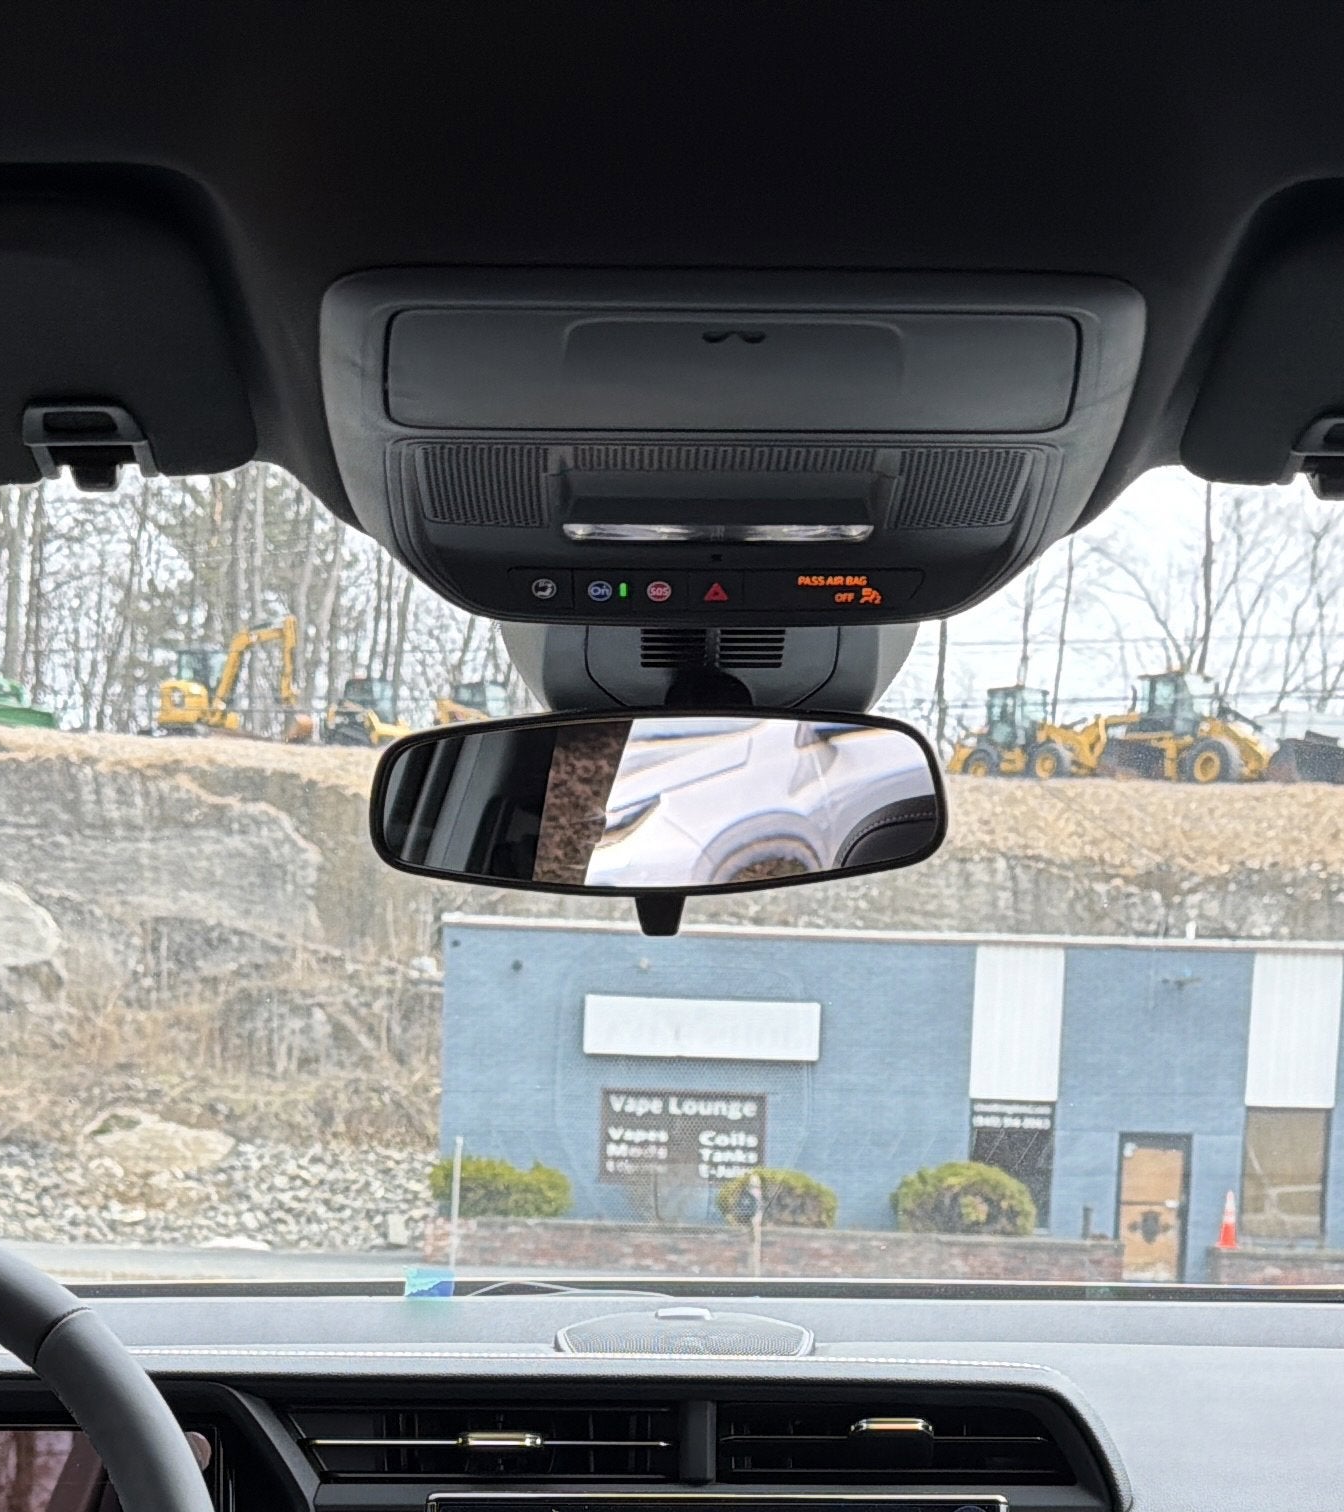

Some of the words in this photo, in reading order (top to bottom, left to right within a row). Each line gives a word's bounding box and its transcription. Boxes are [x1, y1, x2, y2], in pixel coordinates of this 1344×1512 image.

[797, 575, 824, 586] PASS
[825, 575, 844, 586] AIR
[845, 576, 868, 587] BAG
[650, 586, 670, 596] SOS
[834, 592, 855, 603] OFF
[609, 1094, 663, 1116] Vape
[669, 1097, 758, 1120] Lounge
[607, 1126, 669, 1143] Vapes
[699, 1148, 758, 1164] Tanks
